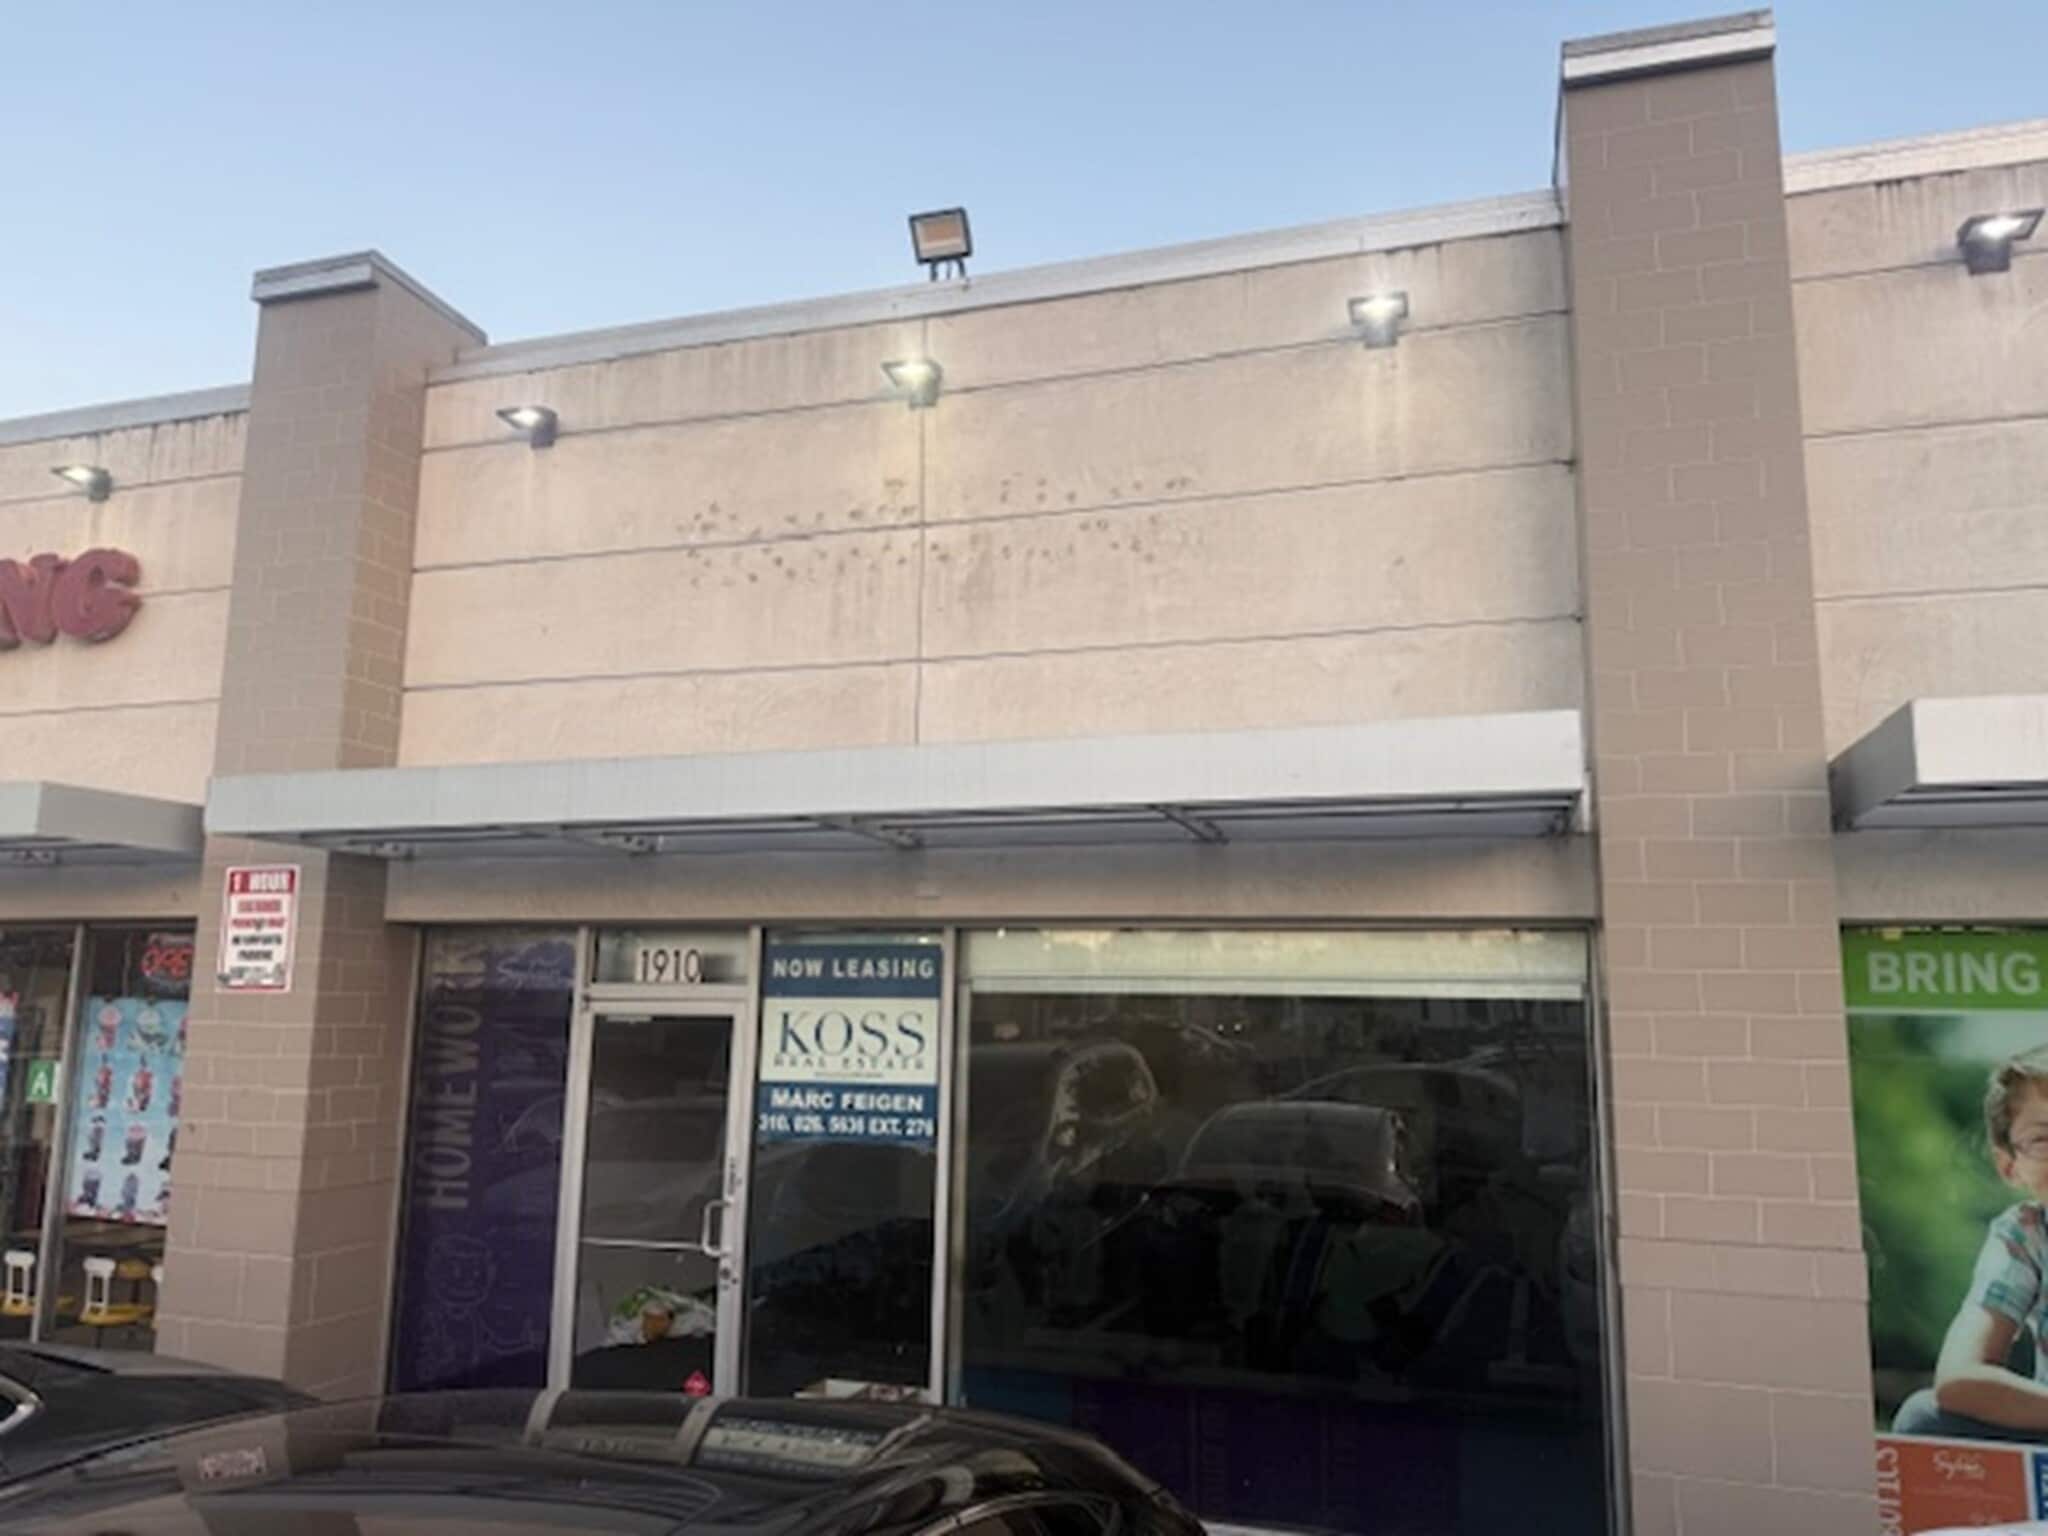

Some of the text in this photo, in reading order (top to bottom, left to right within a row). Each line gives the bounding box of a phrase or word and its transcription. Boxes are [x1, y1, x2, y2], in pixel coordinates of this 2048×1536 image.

[249, 871, 289, 891] HOUR
[641, 949, 702, 983] 1910
[773, 957, 934, 979] NOW LEASING
[1867, 951, 2041, 996] BRING
[779, 1011, 926, 1056] KOSS
[773, 1056, 924, 1070] REAL ESTATE
[31, 1071, 48, 1096] A
[770, 1088, 924, 1112] MARC FEIGEN
